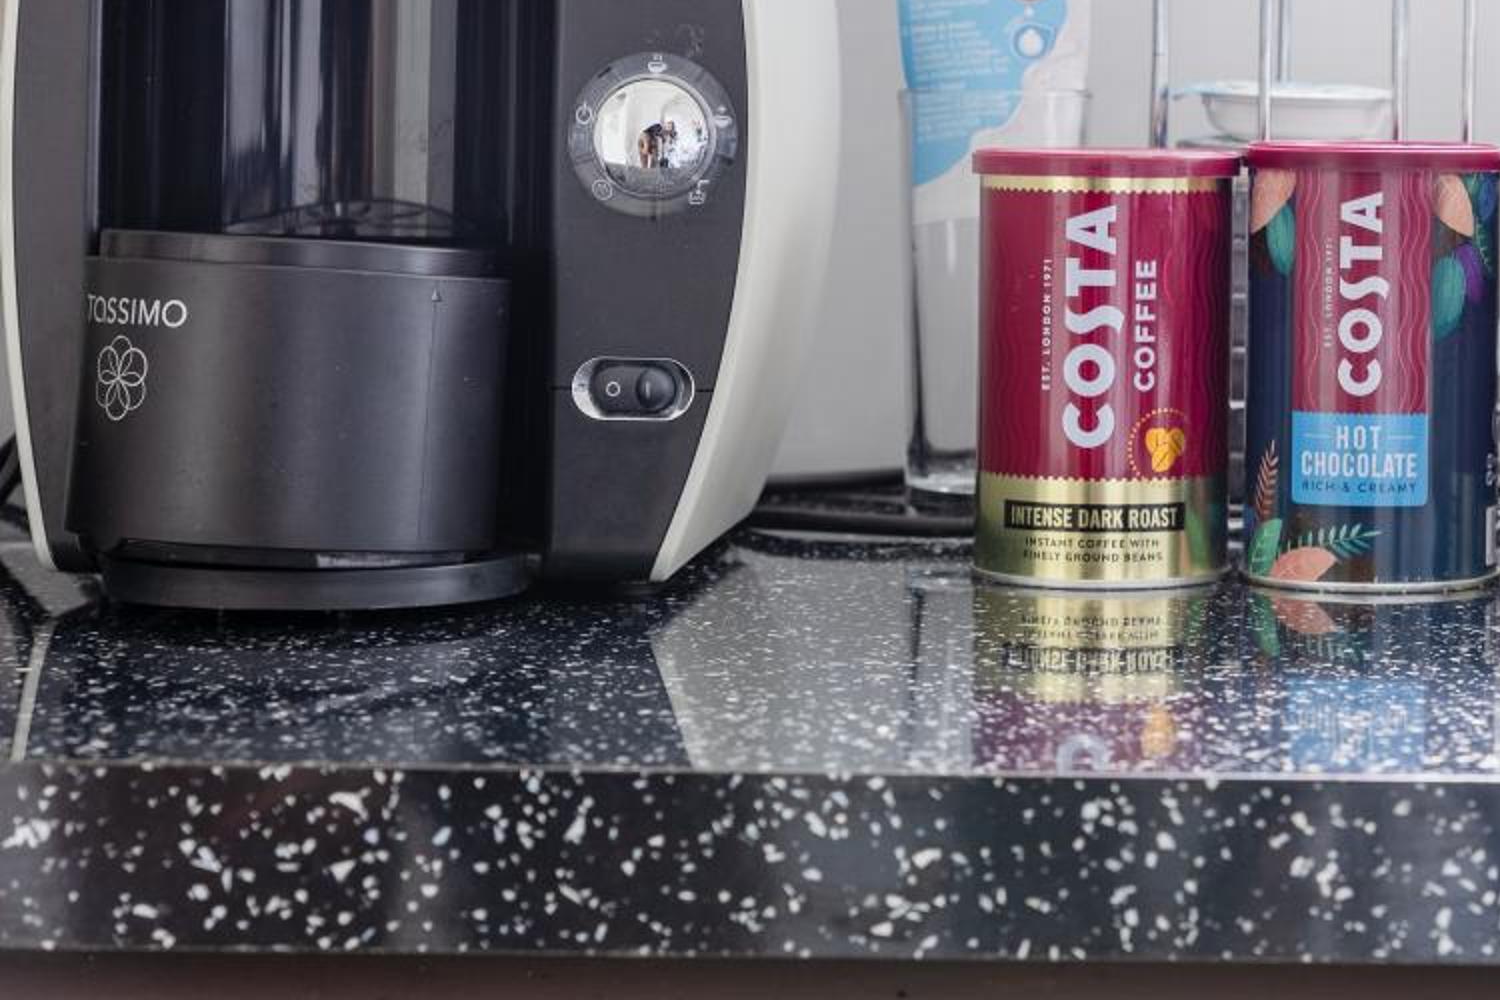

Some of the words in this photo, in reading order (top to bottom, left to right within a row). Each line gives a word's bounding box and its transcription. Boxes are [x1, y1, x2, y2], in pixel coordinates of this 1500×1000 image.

[1043, 258, 1052, 287] 1971
[1338, 192, 1389, 396] COSTA
[87, 293, 188, 328] TASSIMO
[1041, 294, 1051, 355] LONDON
[1063, 205, 1124, 449] COSTA
[1134, 259, 1157, 392] COFFEE
[1042, 362, 1051, 391] EST.
[1336, 425, 1381, 450] HOT
[1301, 451, 1418, 478] CHOCOLATE
[1302, 480, 1335, 491] RICH
[1357, 482, 1417, 493] CREAMY
[1011, 505, 1072, 528] INTENSE
[1079, 509, 1123, 529] DARK
[1129, 508, 1177, 528] ROAST
[1024, 551, 1060, 562] FINELY
[1065, 552, 1119, 563] GROUND
[1124, 552, 1163, 562] BEANS
[1025, 537, 1073, 549] INSTANT
[1077, 538, 1125, 549] COFFEE
[1129, 538, 1159, 548] WITH
